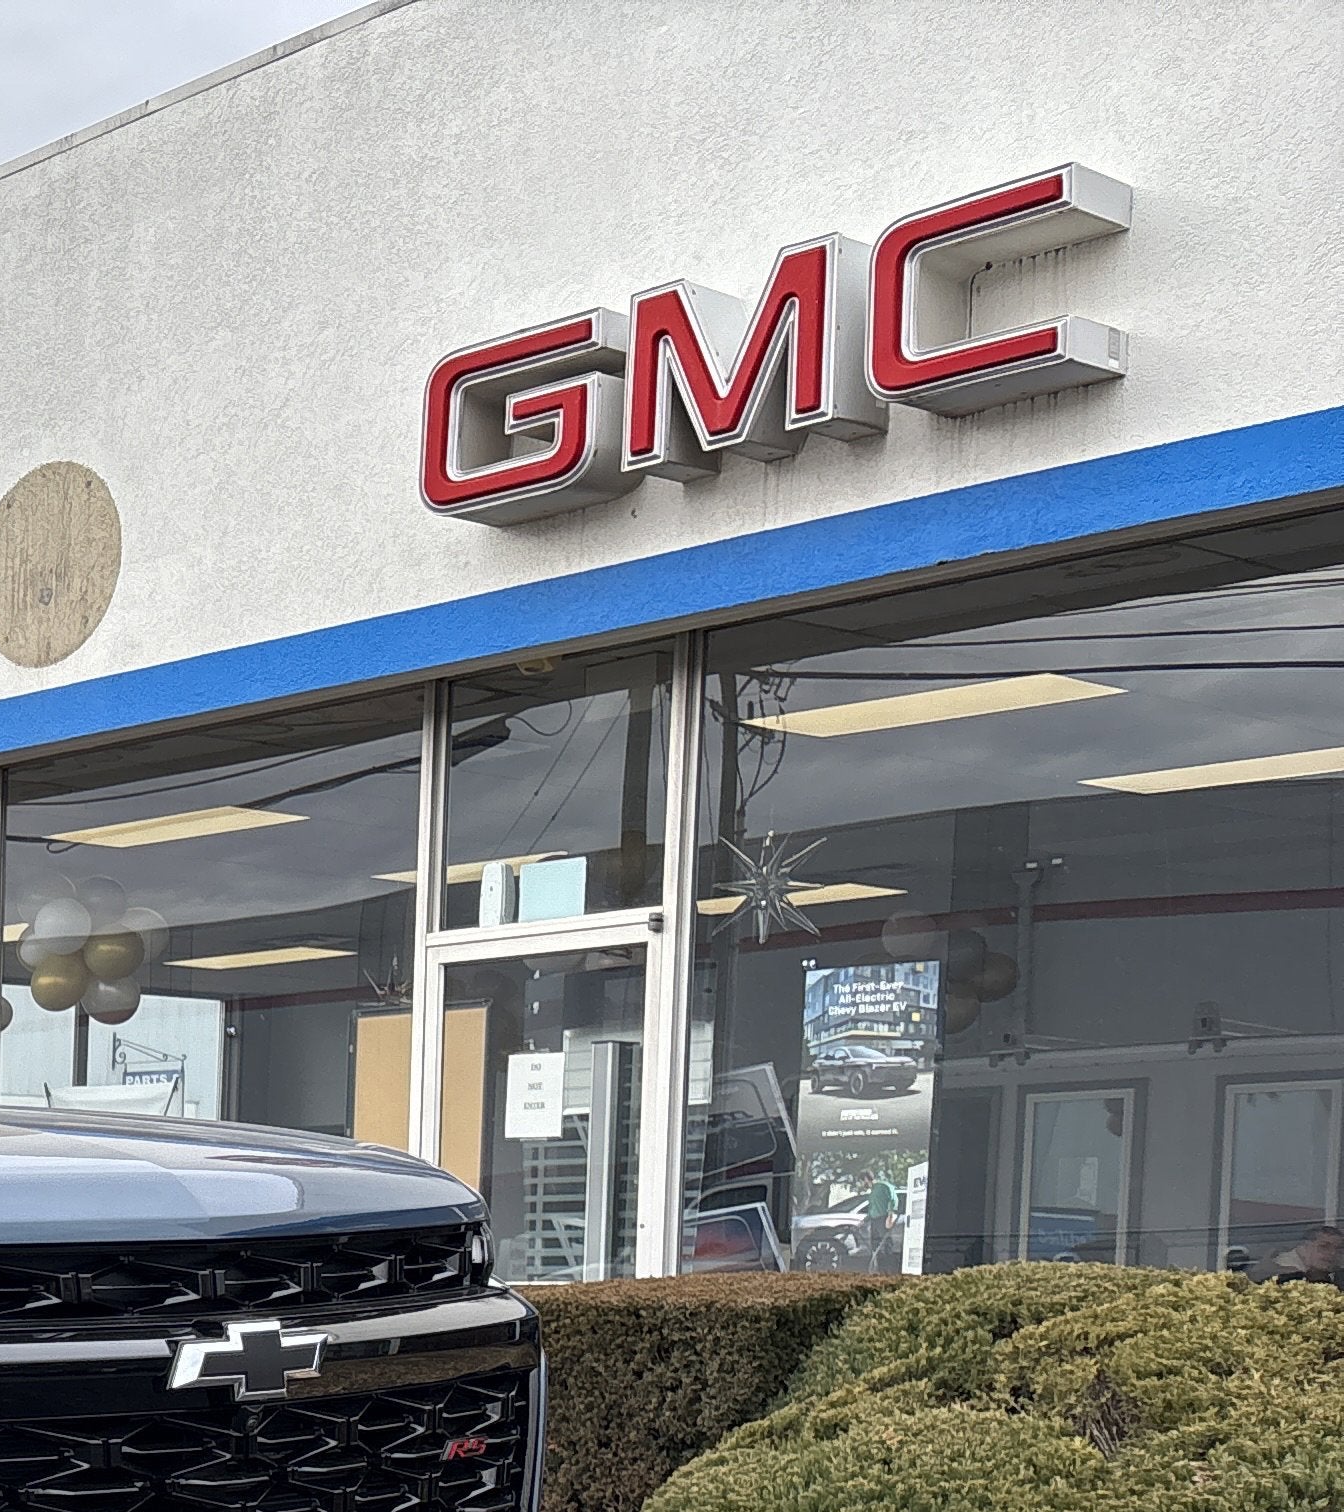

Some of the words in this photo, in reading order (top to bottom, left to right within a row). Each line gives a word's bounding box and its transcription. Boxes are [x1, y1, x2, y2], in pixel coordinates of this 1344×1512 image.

[419, 162, 1078, 517] GMC
[833, 983, 851, 994] The
[852, 980, 904, 994] First-Ever
[839, 992, 895, 1004] All-Electric
[828, 1005, 857, 1016] Chevy
[858, 1003, 891, 1014] Blazer
[892, 1001, 907, 1012] EV
[125, 1074, 168, 1086] PARTS
